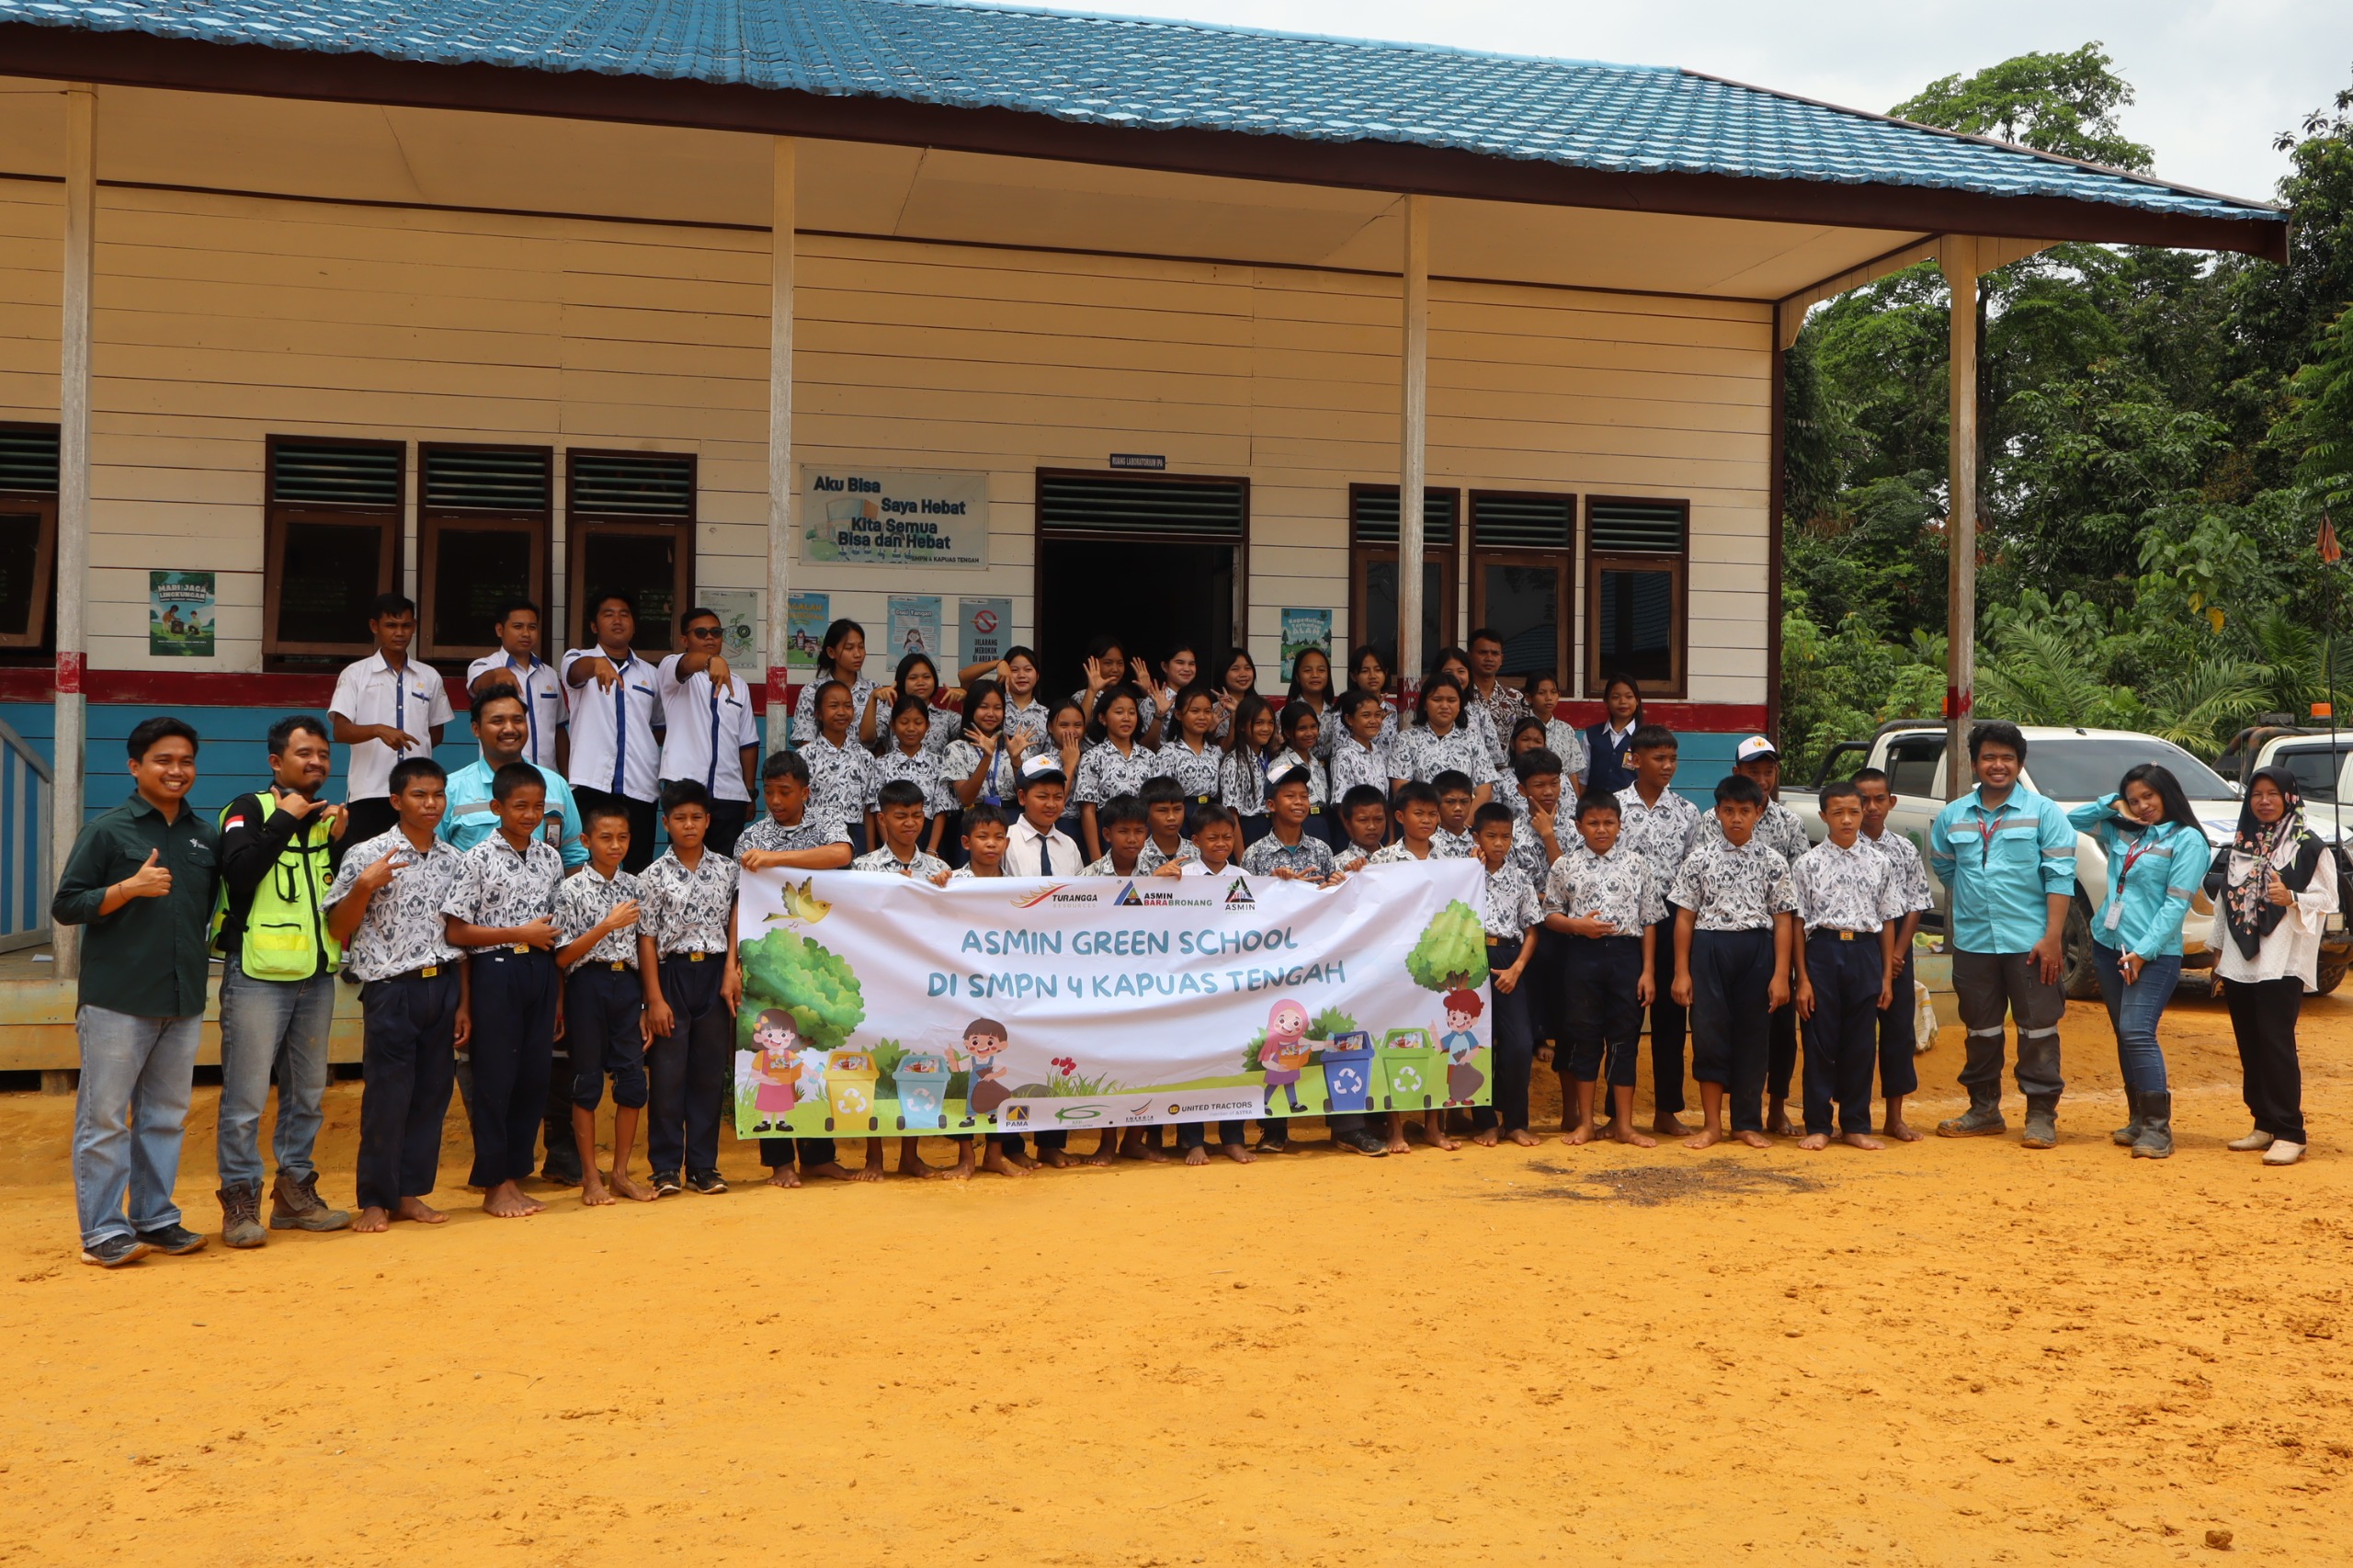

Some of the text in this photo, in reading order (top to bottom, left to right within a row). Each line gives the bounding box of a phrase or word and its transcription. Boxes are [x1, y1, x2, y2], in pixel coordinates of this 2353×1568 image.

[813, 476, 881, 494] Aku Bisa
[881, 497, 966, 516] Saya Hebat
[851, 517, 938, 534] Kita Semua
[837, 531, 951, 550] Bisa dan Hebat
[184, 585, 207, 593] JAGA
[1052, 893, 1098, 903] TURANGGA
[1143, 899, 1213, 907] BARABRONANG
[961, 926, 1299, 956] ASMIN GREEN SCHOOL
[927, 960, 1347, 999] DI SMPN 4 KAPUAS TENGAH
[1181, 1104, 1210, 1112] UNITED
[1211, 1101, 1253, 1109] TRACTORS
